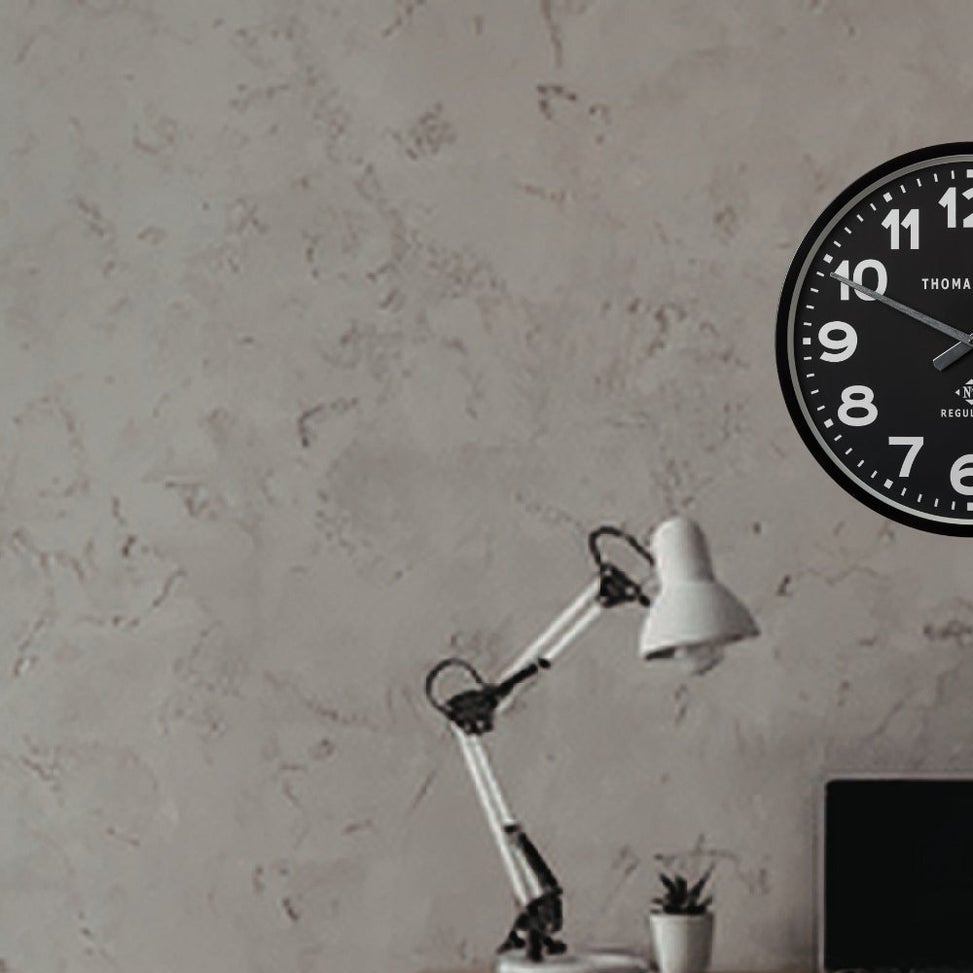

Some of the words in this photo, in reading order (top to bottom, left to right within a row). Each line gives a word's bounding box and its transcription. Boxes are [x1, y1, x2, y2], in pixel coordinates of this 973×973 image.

[881, 209, 919, 249] 11
[833, 259, 888, 301] 10
[818, 321, 857, 362] 9
[838, 385, 878, 426] 8
[889, 437, 923, 477] 7
